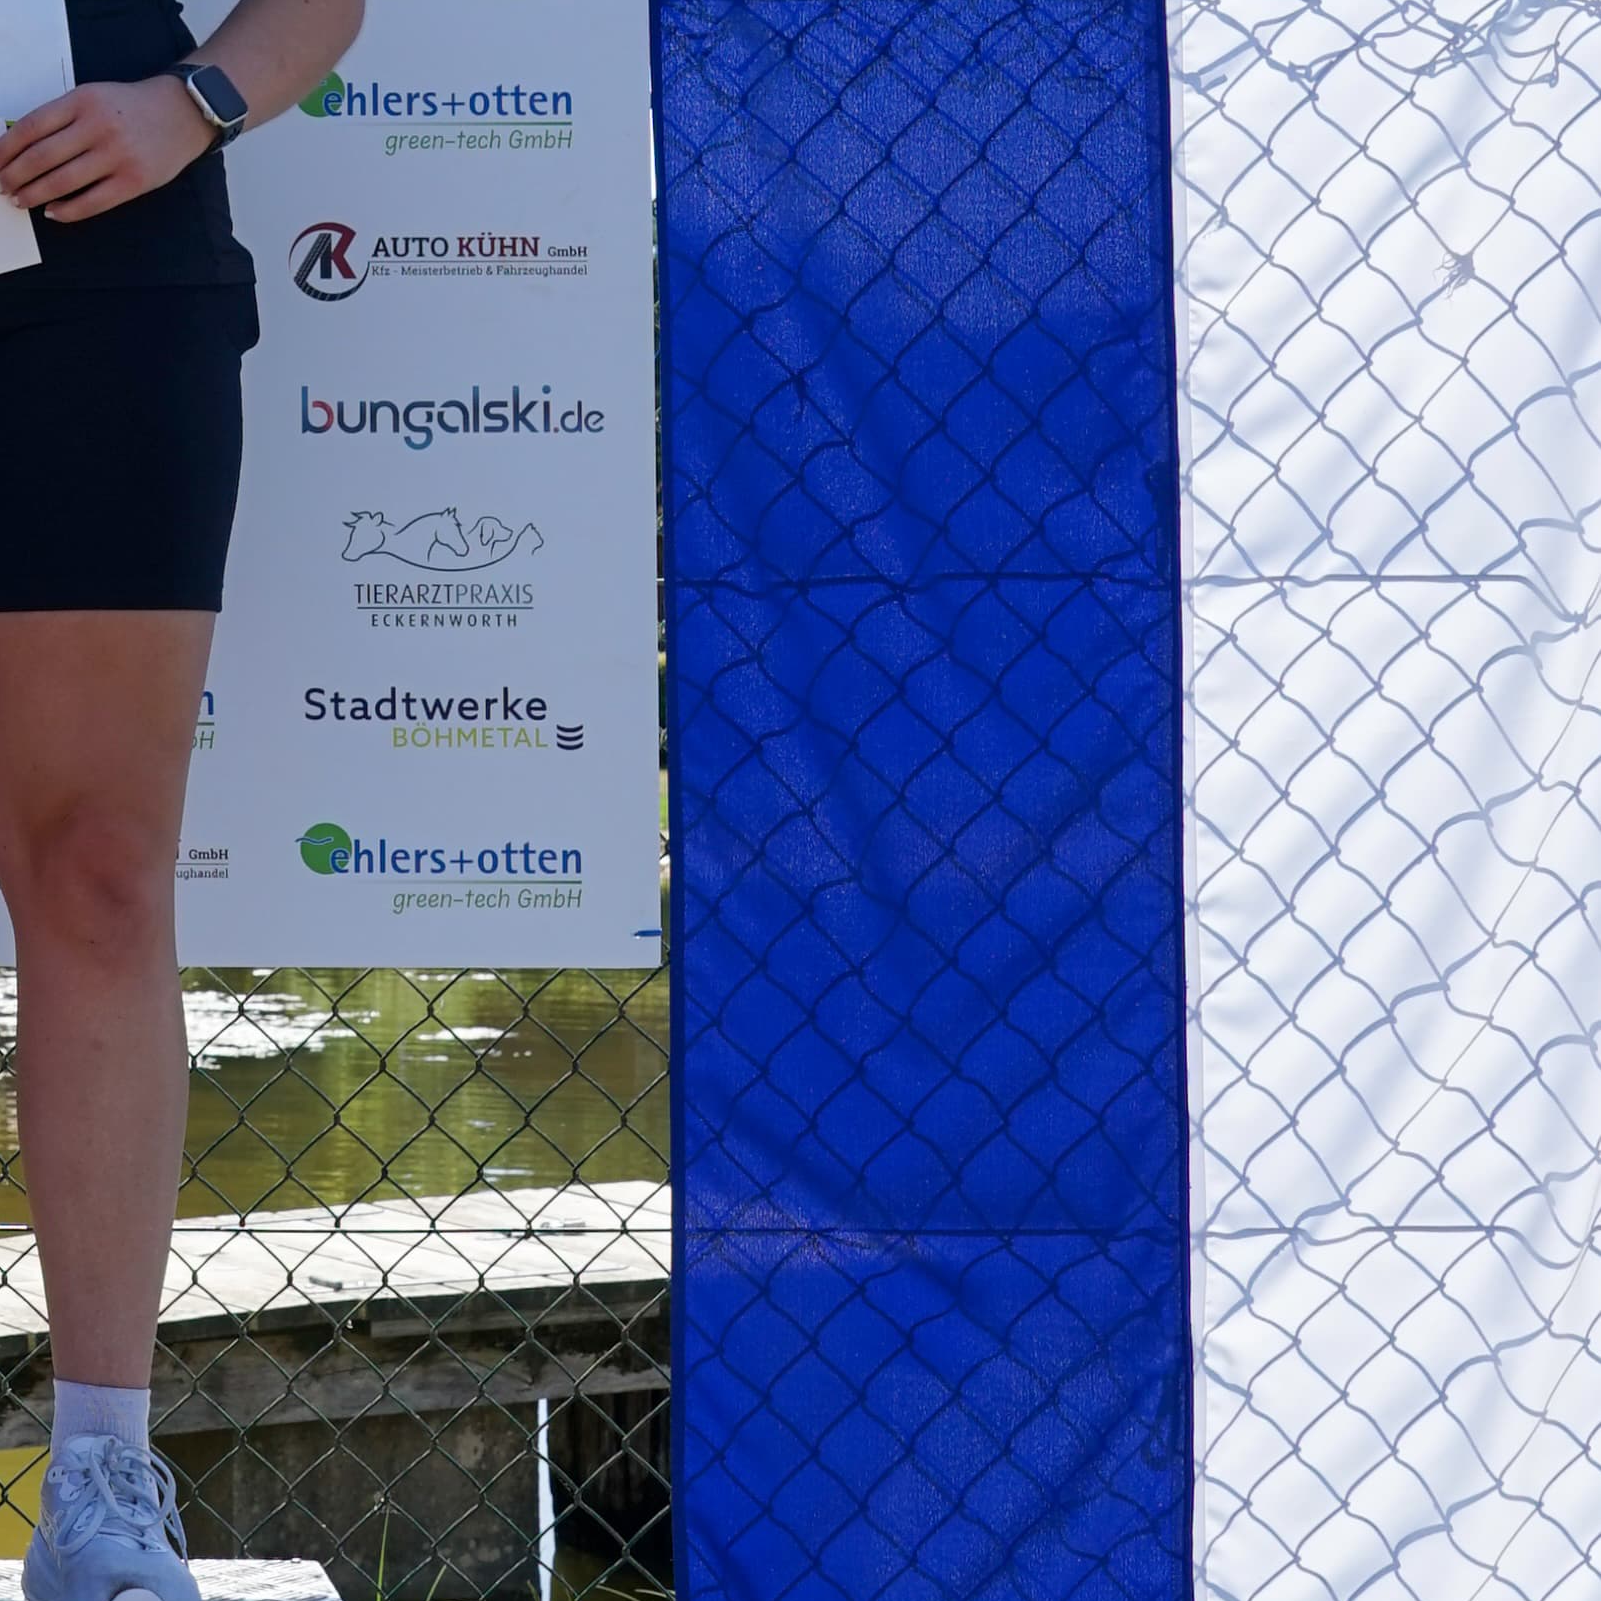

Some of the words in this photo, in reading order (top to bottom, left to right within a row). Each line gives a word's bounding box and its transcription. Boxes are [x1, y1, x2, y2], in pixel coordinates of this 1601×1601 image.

[323, 82, 573, 117] ehlers+otten
[385, 129, 502, 156] green-tech
[509, 129, 573, 150] GmbH
[371, 237, 449, 258] AUTO
[456, 232, 541, 258] KÜHN
[548, 246, 588, 258] GmbH
[371, 265, 391, 277] Kfz
[401, 264, 483, 277] Meisterbetrieb
[496, 264, 588, 278] Fahrzeughandel
[300, 384, 605, 451] bungalski.de
[354, 584, 534, 605] TIERARZTPRAXIS
[371, 613, 518, 627] ECKERNWORTH
[304, 686, 547, 721] Stadtwerke
[392, 722, 549, 748] BÖHMETAL
[189, 849, 229, 861] GmbH
[330, 839, 583, 875] ehlers+otten
[392, 888, 510, 914] green-tech
[517, 888, 583, 909] GmbH
